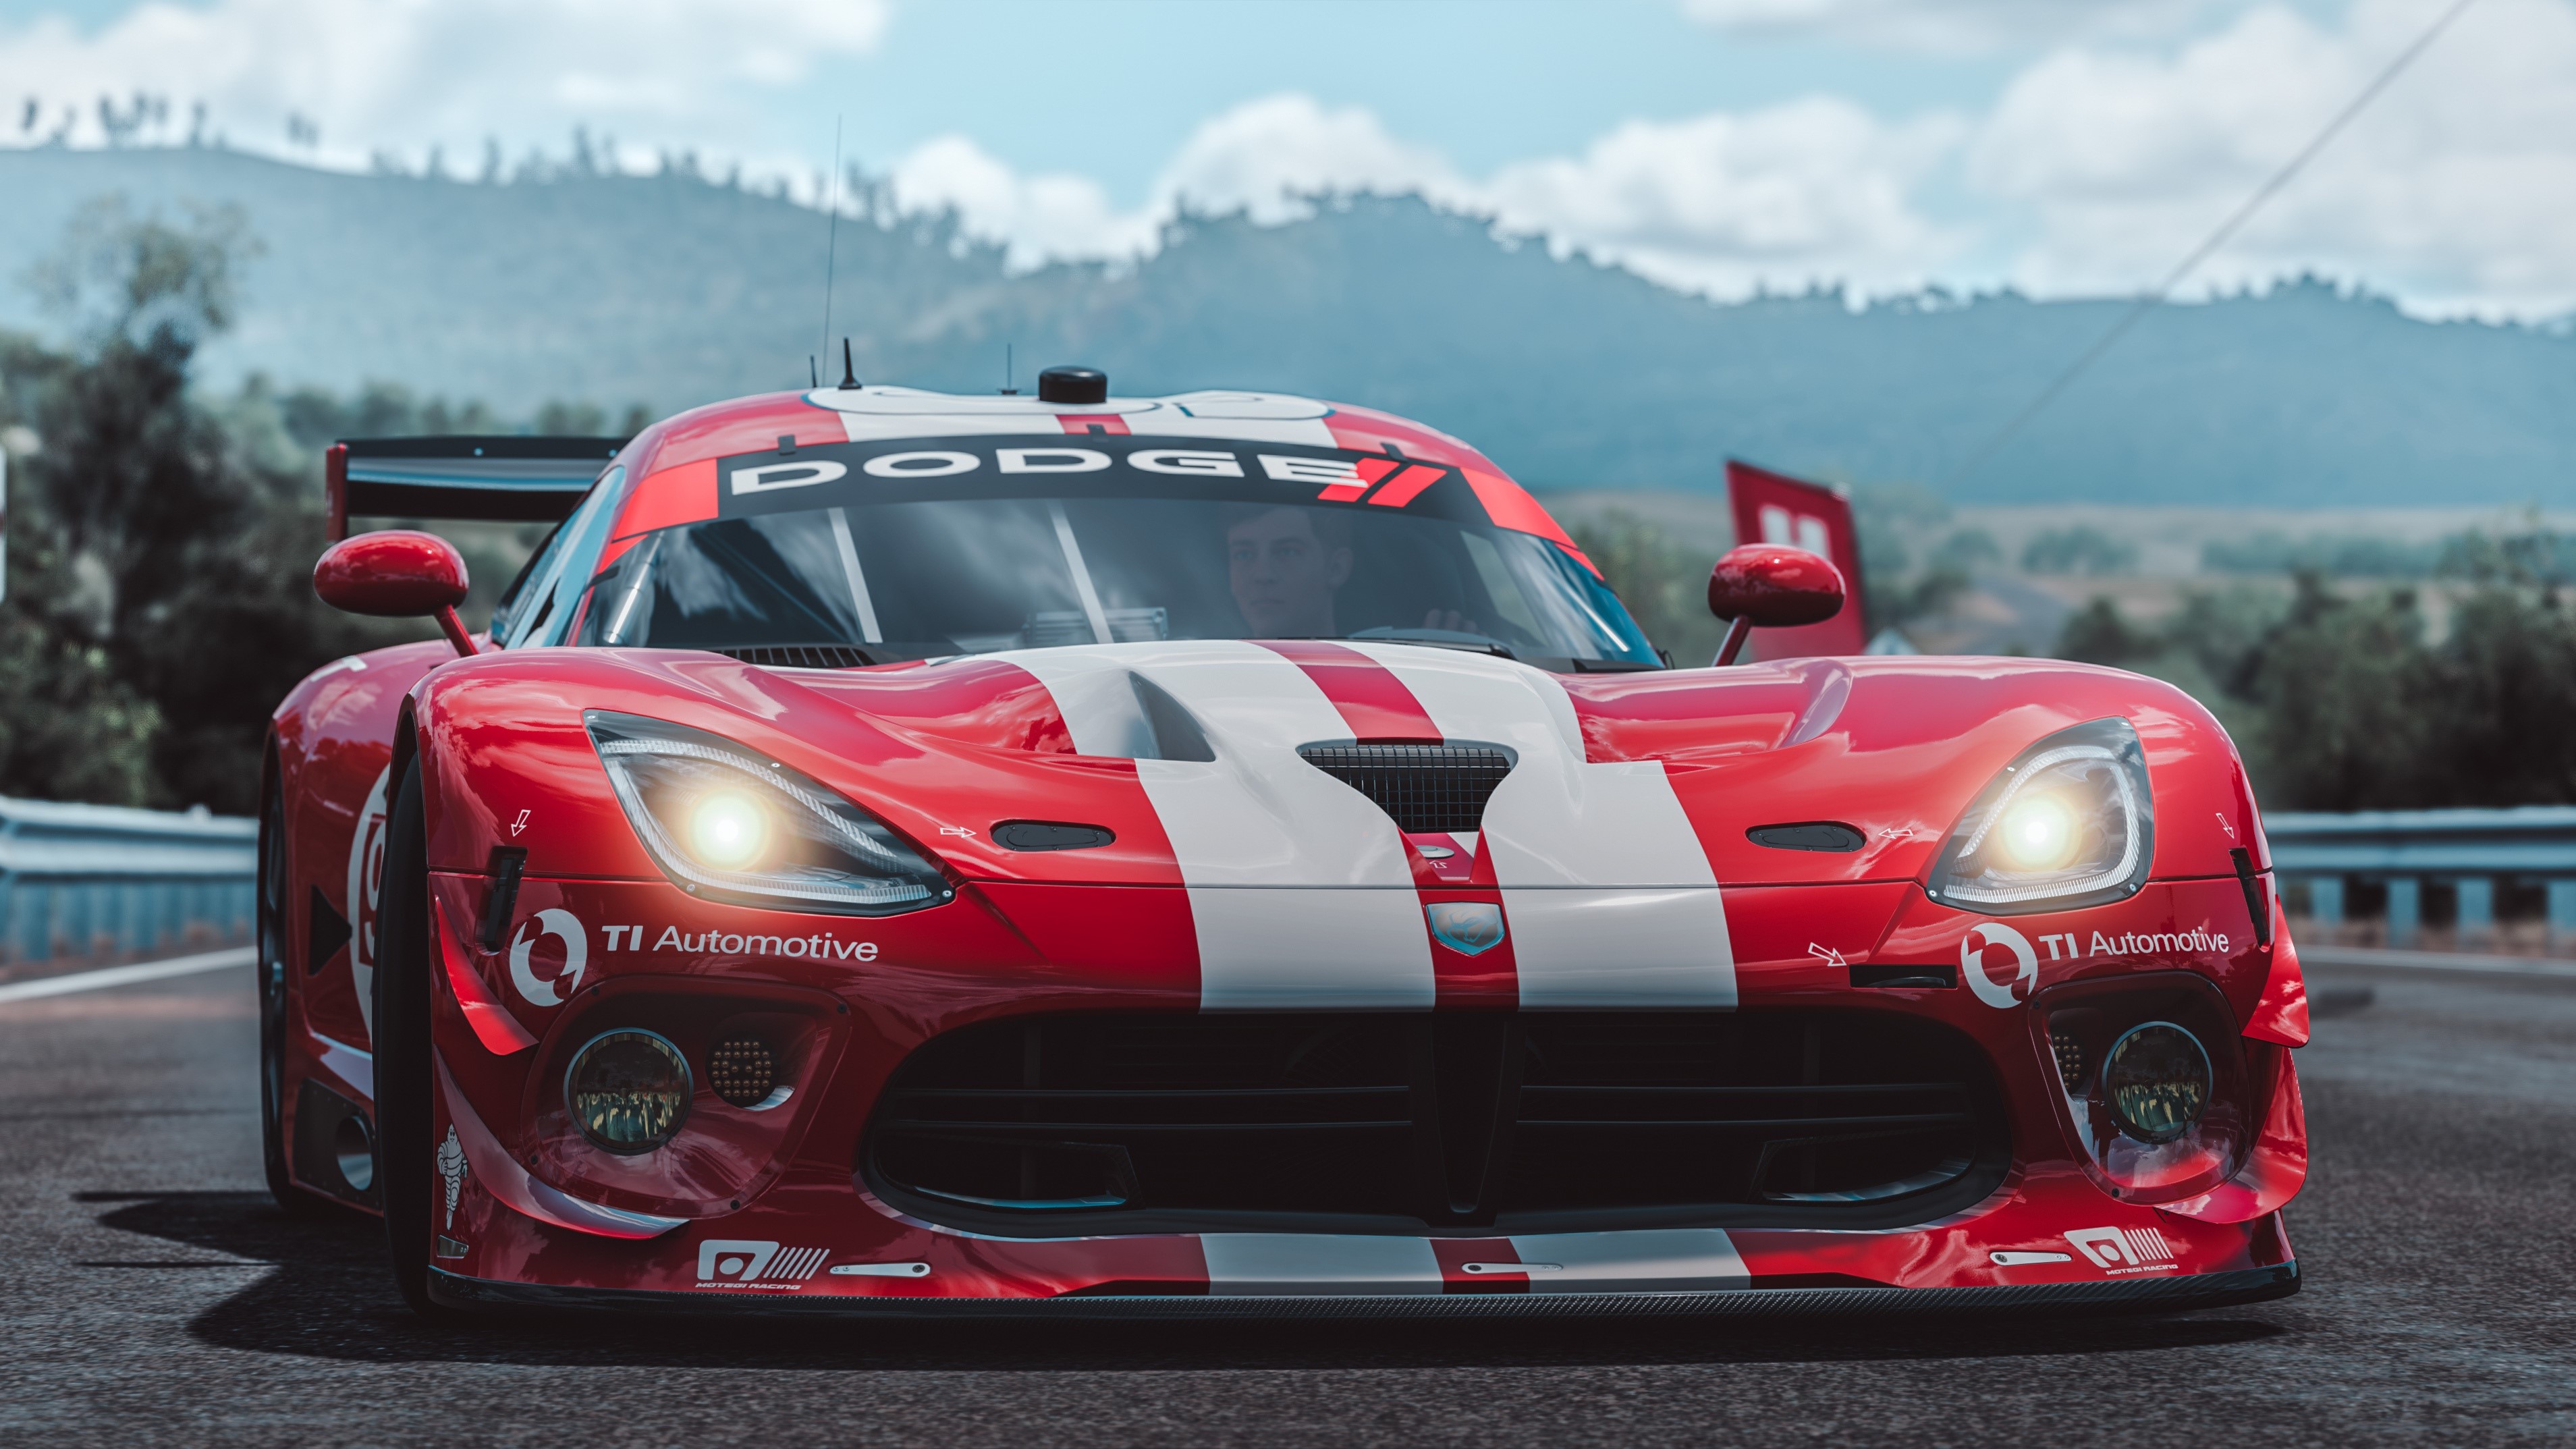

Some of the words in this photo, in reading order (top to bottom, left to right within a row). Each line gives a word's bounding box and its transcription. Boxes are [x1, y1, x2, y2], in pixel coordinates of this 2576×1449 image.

[731, 448, 1369, 495] DODGE
[601, 925, 644, 952] TI
[652, 925, 878, 962] Automotive
[2038, 933, 2079, 960] TI
[2089, 926, 2229, 958] Automotive
[2105, 1267, 2143, 1276] MOTEGI
[2143, 1263, 2179, 1272] RACING
